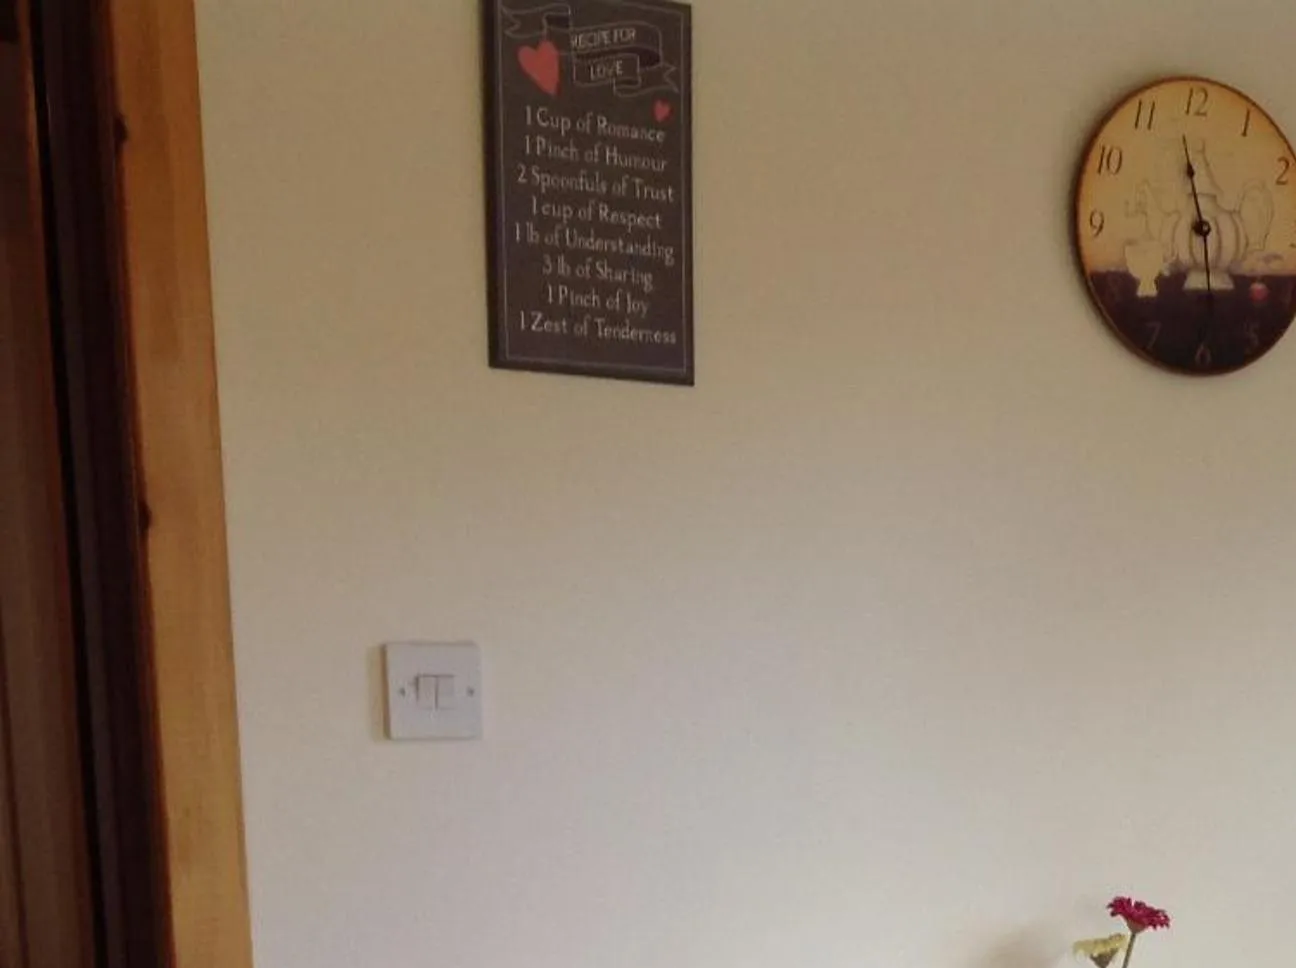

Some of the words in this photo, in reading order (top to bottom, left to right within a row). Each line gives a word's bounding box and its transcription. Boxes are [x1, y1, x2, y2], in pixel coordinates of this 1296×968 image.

[613, 28, 636, 43] FOR
[590, 60, 623, 80] LOVE
[1134, 99, 1156, 131] 11
[1185, 87, 1209, 117] 12
[525, 105, 532, 126] 1
[536, 107, 571, 136] Cup
[576, 112, 593, 134] of
[597, 115, 666, 142] Romance
[1241, 107, 1251, 137] 1
[525, 135, 530, 155] 1
[536, 136, 579, 162] Pinch
[584, 144, 600, 164] of
[605, 147, 667, 172] Humour
[1097, 145, 1123, 175] 10
[517, 163, 527, 183] 2
[532, 165, 607, 193] Spoonfuls
[612, 172, 629, 195] of
[633, 178, 674, 203] Trust
[1276, 156, 1290, 185] 2
[532, 196, 537, 216] 1
[578, 202, 595, 222] of
[599, 204, 661, 233] Respect
[1089, 210, 1104, 238] 9
[515, 222, 520, 243] 1
[526, 223, 539, 244] lb
[545, 225, 563, 246] of
[566, 228, 674, 266] Understanding
[543, 254, 551, 275] 3
[558, 255, 571, 275] lb
[575, 257, 592, 278] of
[596, 261, 653, 292] Sharing
[548, 284, 553, 304] 1
[559, 285, 600, 308] Pinch
[606, 290, 622, 310] of
[627, 294, 648, 318] Joy
[520, 311, 525, 331] 1
[531, 311, 567, 334] Zest
[574, 316, 590, 337] of
[594, 319, 676, 344] Tenderness
